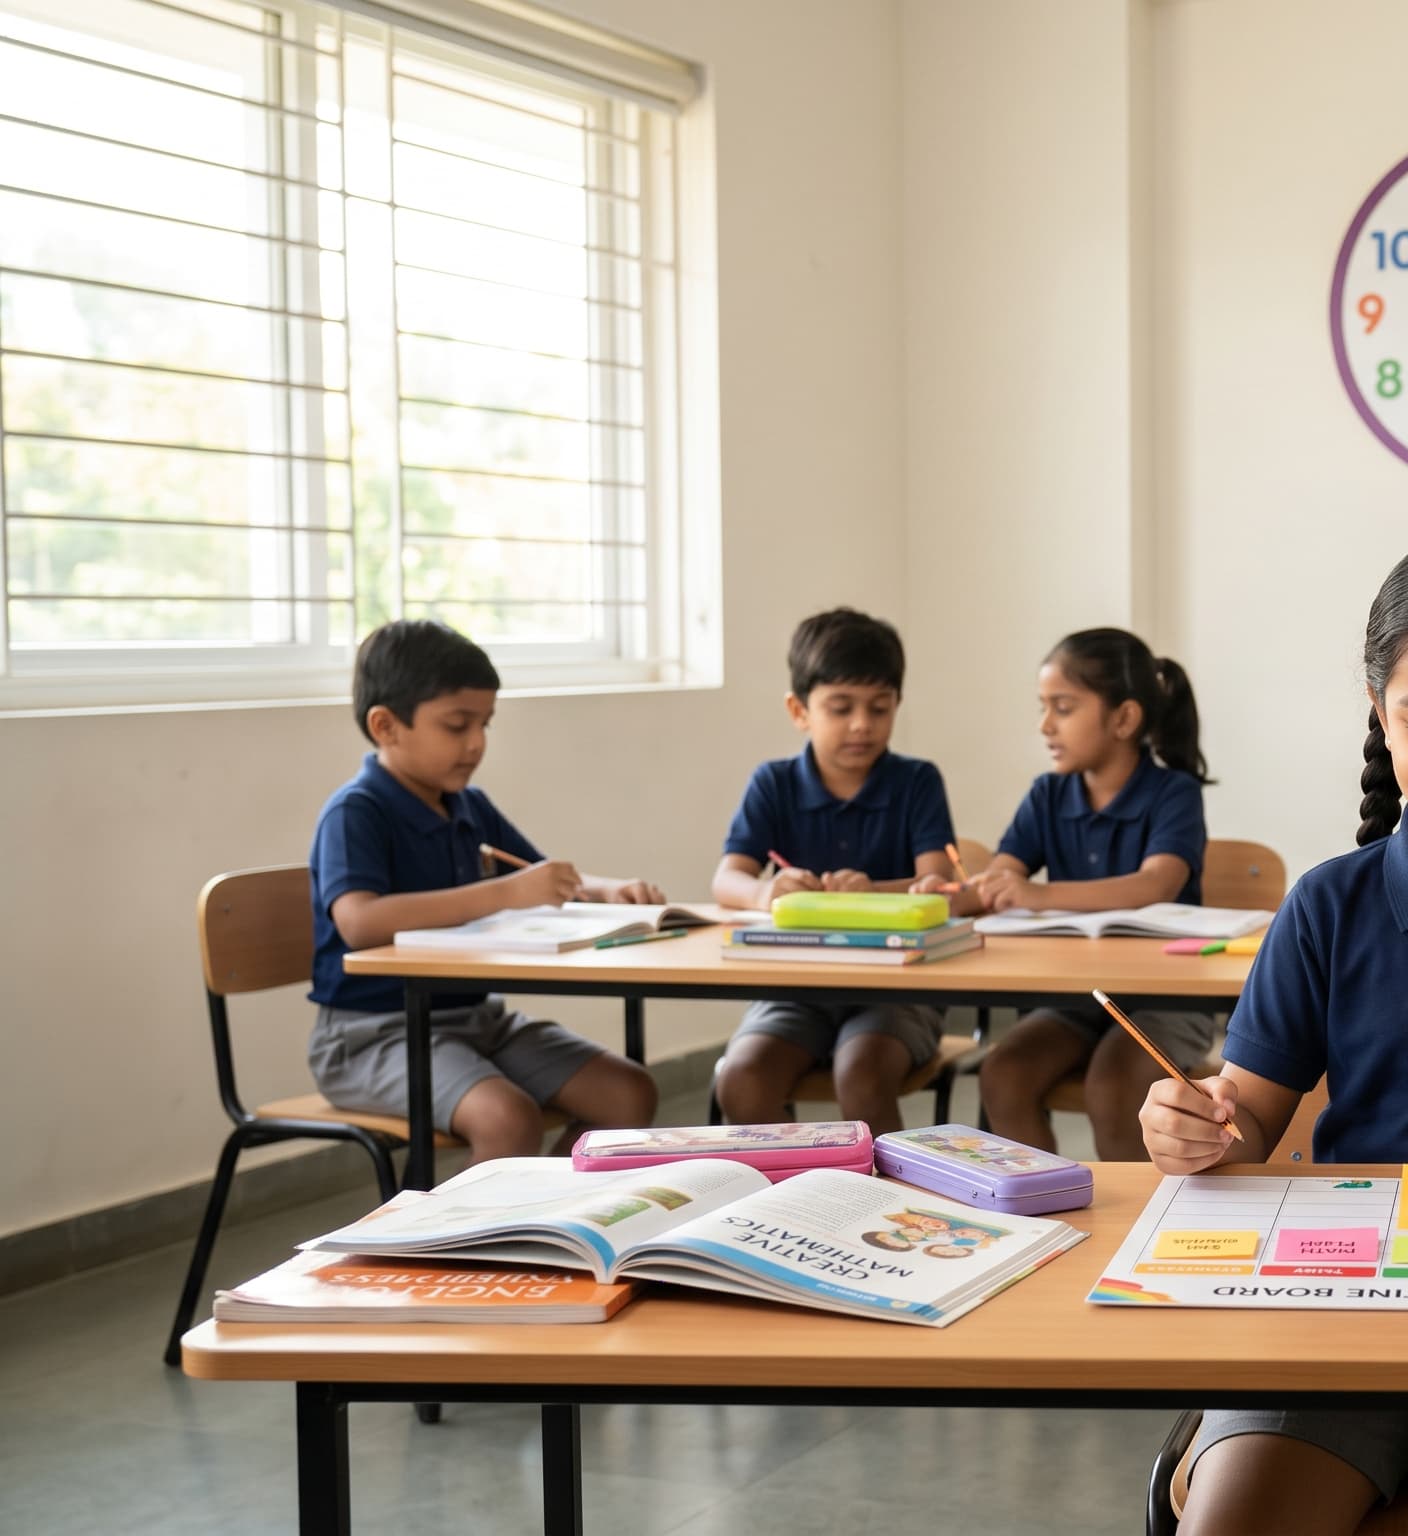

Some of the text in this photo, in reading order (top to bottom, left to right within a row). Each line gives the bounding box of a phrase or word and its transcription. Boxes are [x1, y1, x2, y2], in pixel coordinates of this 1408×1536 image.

[1358, 293, 1384, 334] 9
[1376, 359, 1403, 398] 8
[721, 1215, 915, 1279] MATHEMATICS
[733, 1232, 870, 1281] CREATIVE
[1212, 1285, 1333, 1298] BOARD
